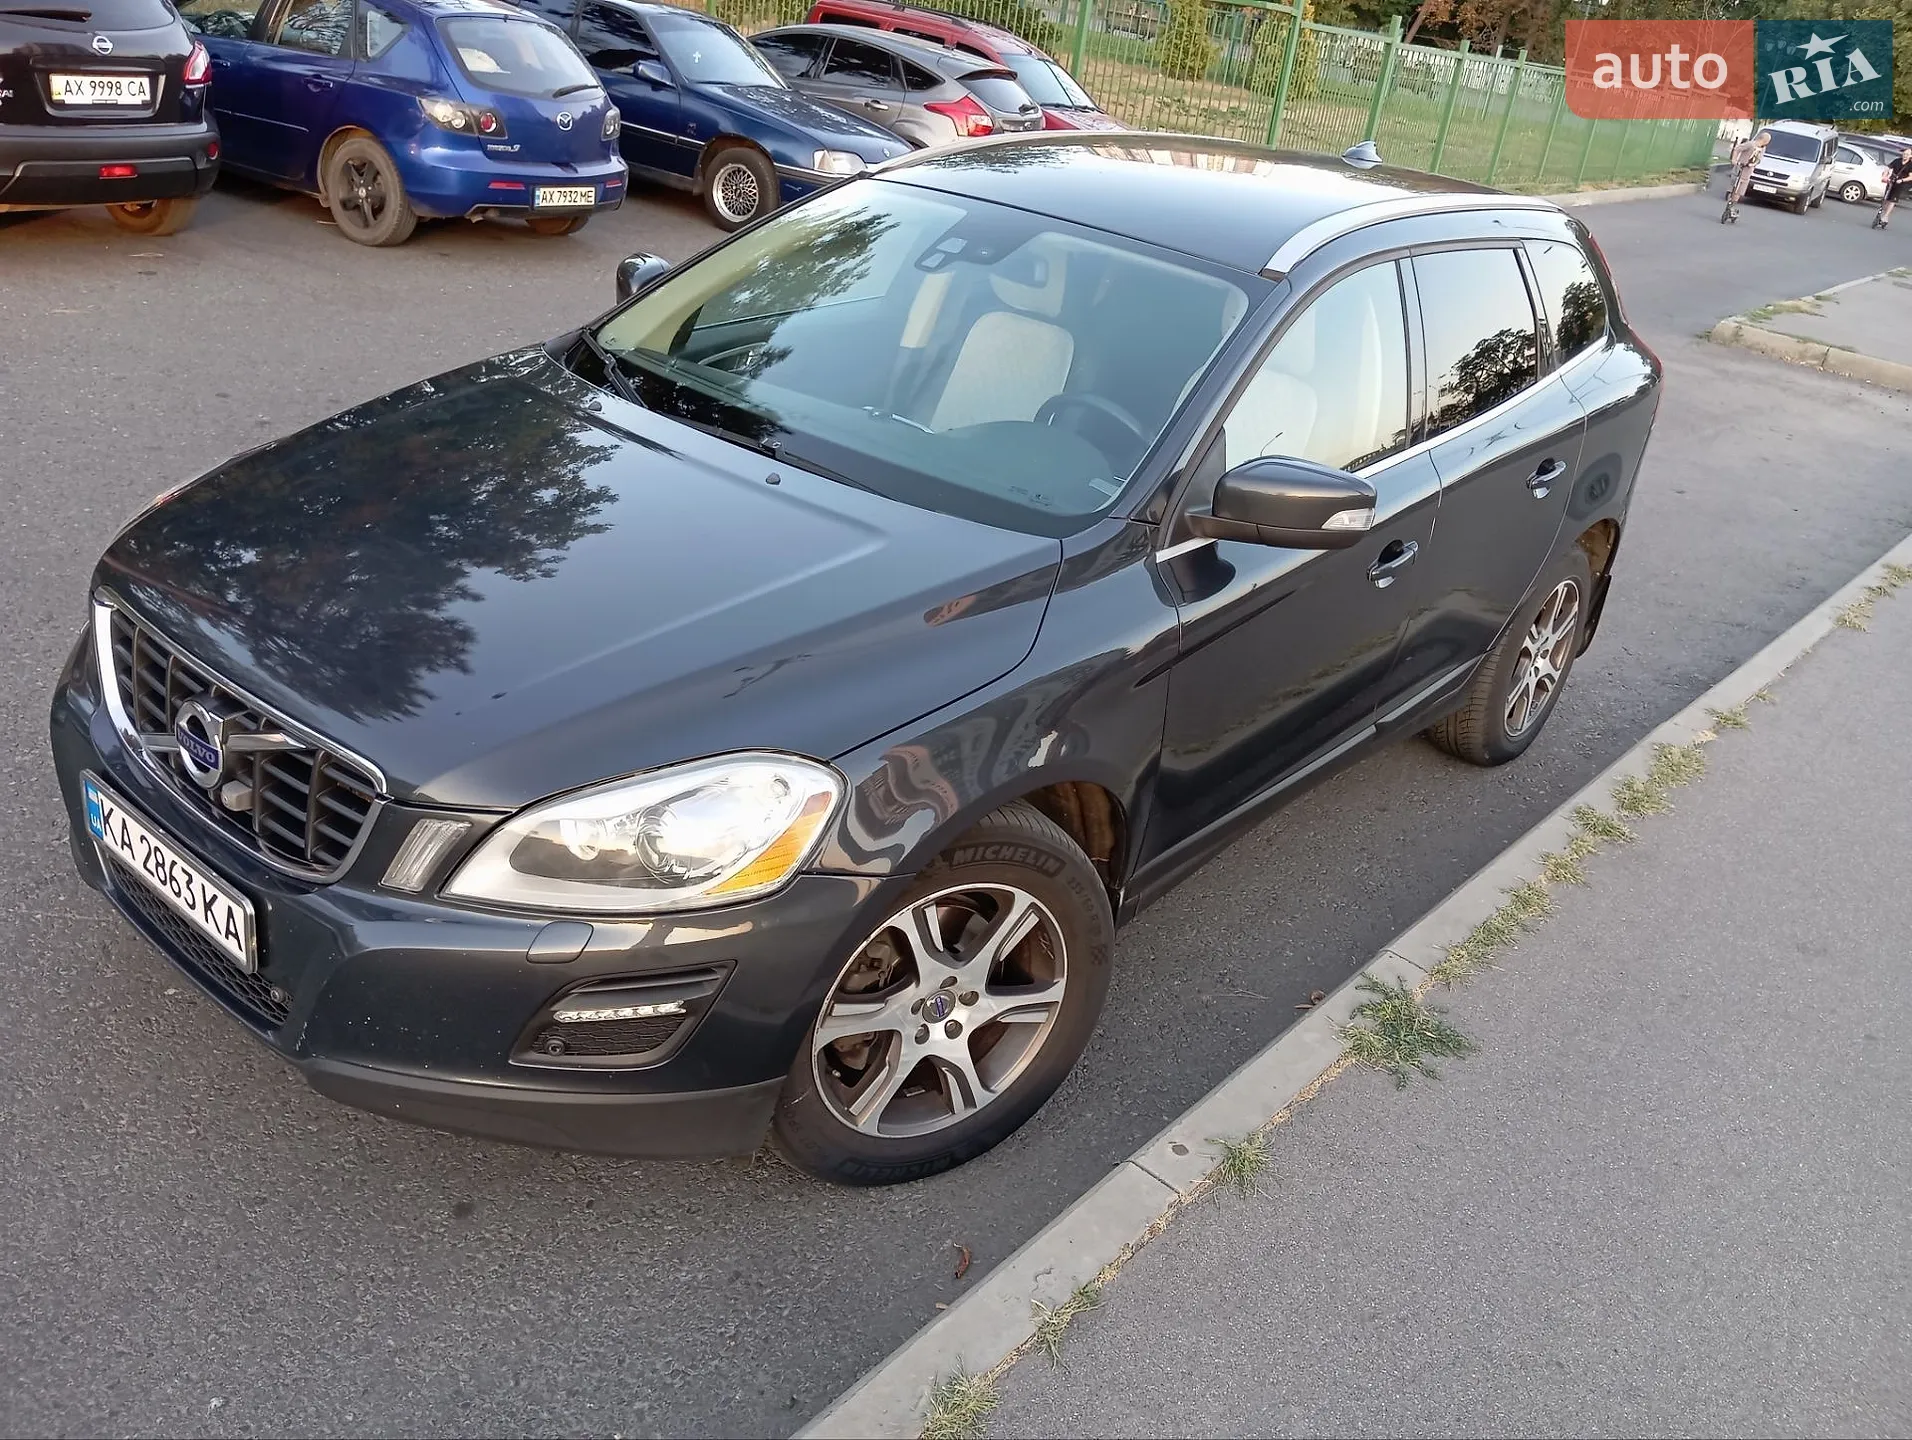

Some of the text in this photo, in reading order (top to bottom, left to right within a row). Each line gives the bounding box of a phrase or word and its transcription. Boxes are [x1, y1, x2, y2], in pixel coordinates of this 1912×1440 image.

[64, 79, 146, 96] AX 9998 CA
[541, 190, 554, 204] AX
[556, 190, 579, 204] 7932
[579, 190, 594, 203] ME
[177, 727, 216, 763] VOLVO
[91, 813, 103, 833] UA
[952, 844, 1062, 874] MICHELIN
[101, 797, 244, 952] KA 2863 KA
